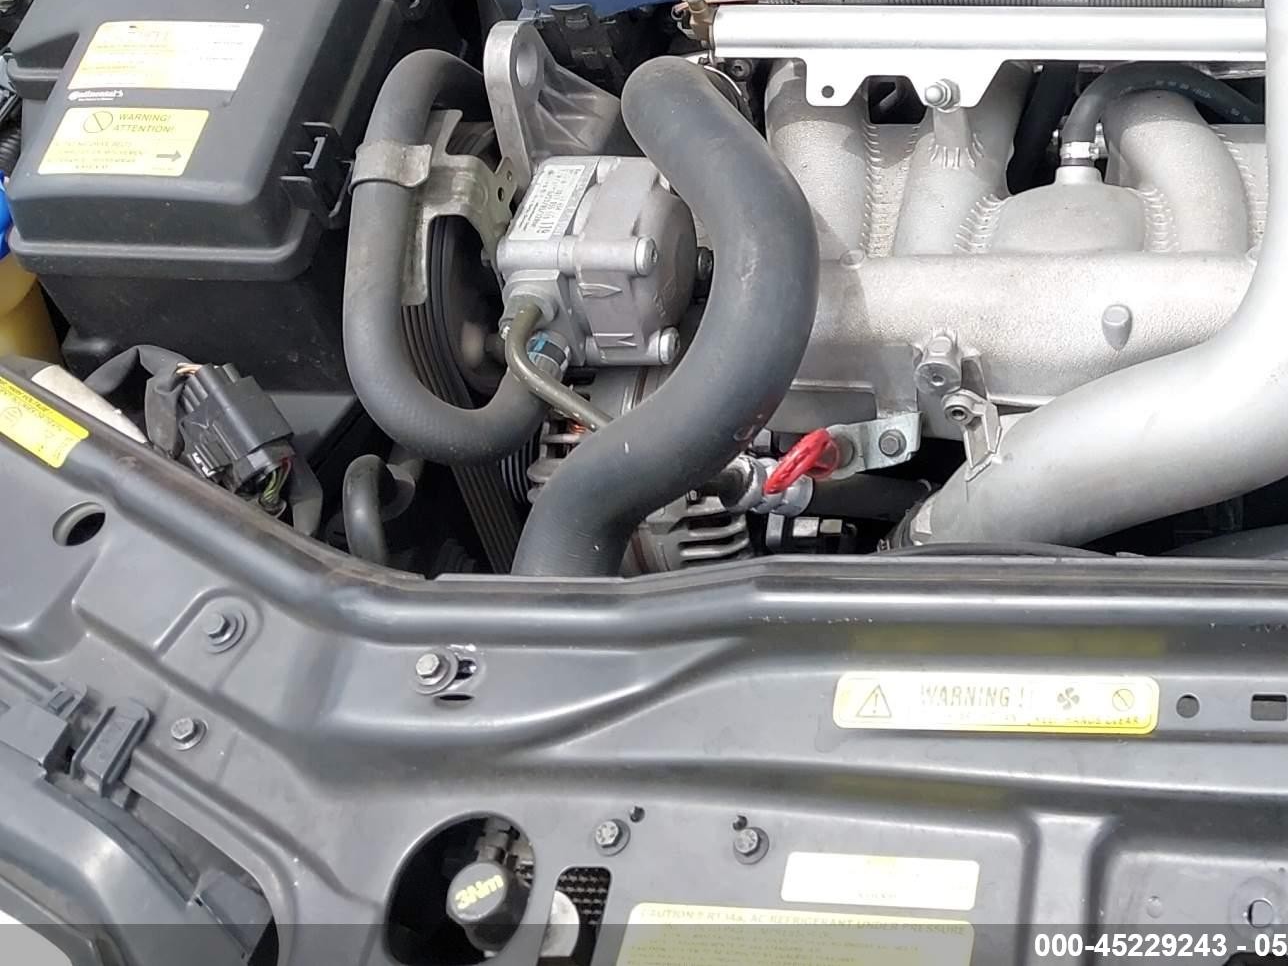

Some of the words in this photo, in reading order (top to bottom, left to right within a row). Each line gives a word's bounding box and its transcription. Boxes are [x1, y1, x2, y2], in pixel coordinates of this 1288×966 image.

[118, 113, 171, 122] WARNING!
[112, 124, 175, 133] ATTENTION!
[920, 685, 1010, 708] WARNING
[455, 874, 504, 909] 3Nm
